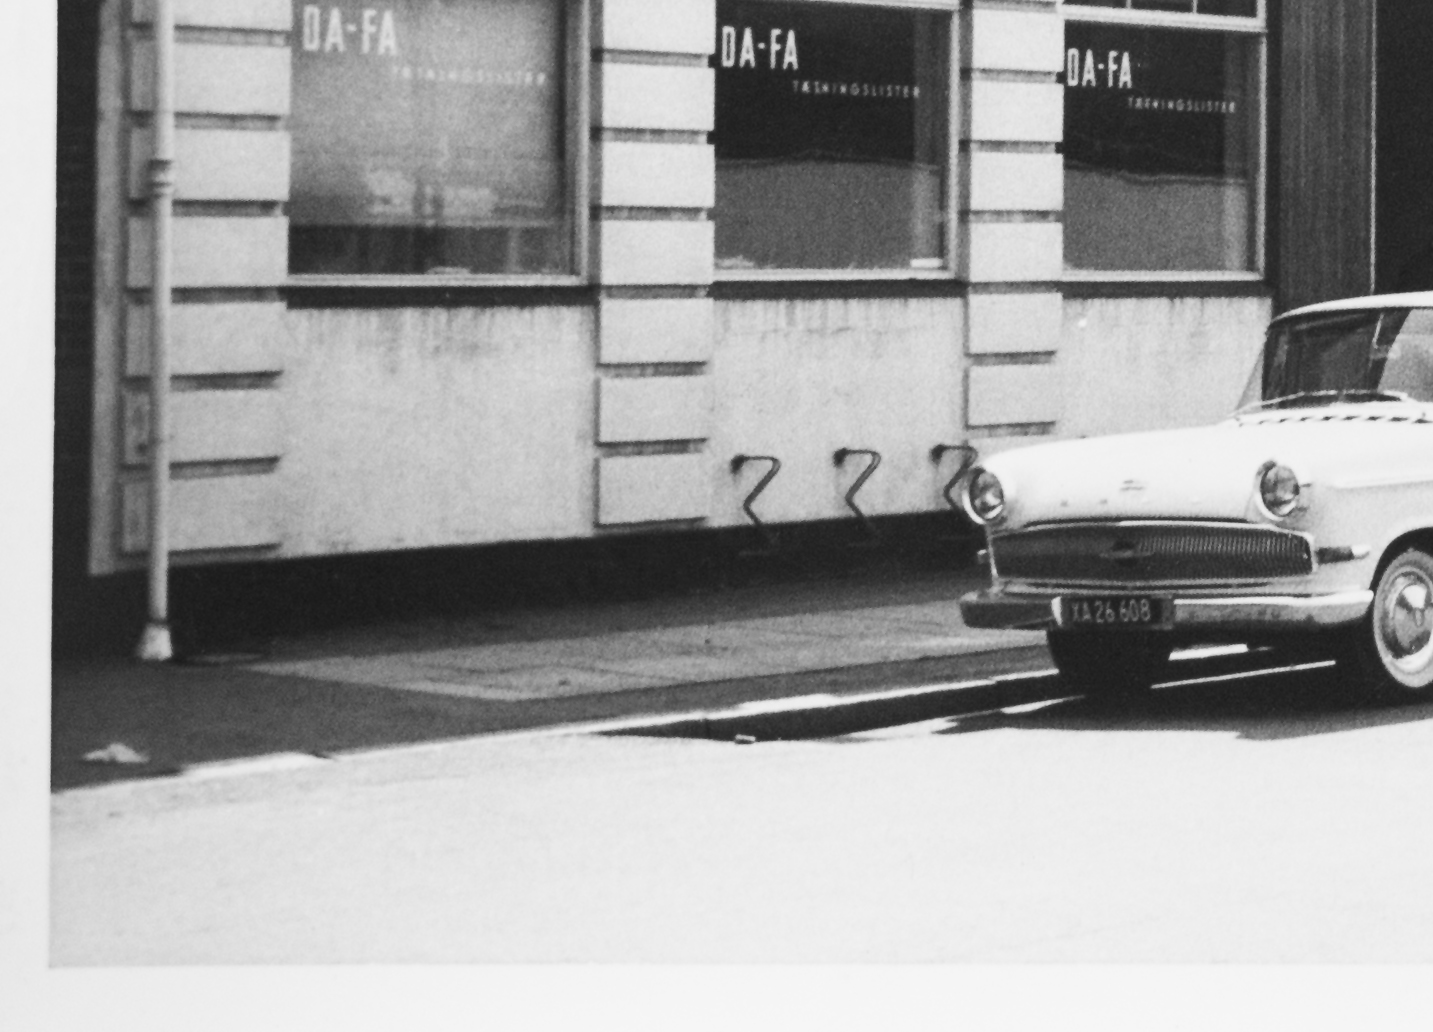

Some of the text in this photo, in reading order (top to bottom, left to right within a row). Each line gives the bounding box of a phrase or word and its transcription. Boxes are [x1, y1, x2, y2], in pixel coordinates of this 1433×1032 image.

[302, 3, 399, 57] DA-FA
[720, 24, 800, 72] DA-FA
[1066, 47, 1133, 90] DA-FA
[1119, 598, 1151, 623] 608
